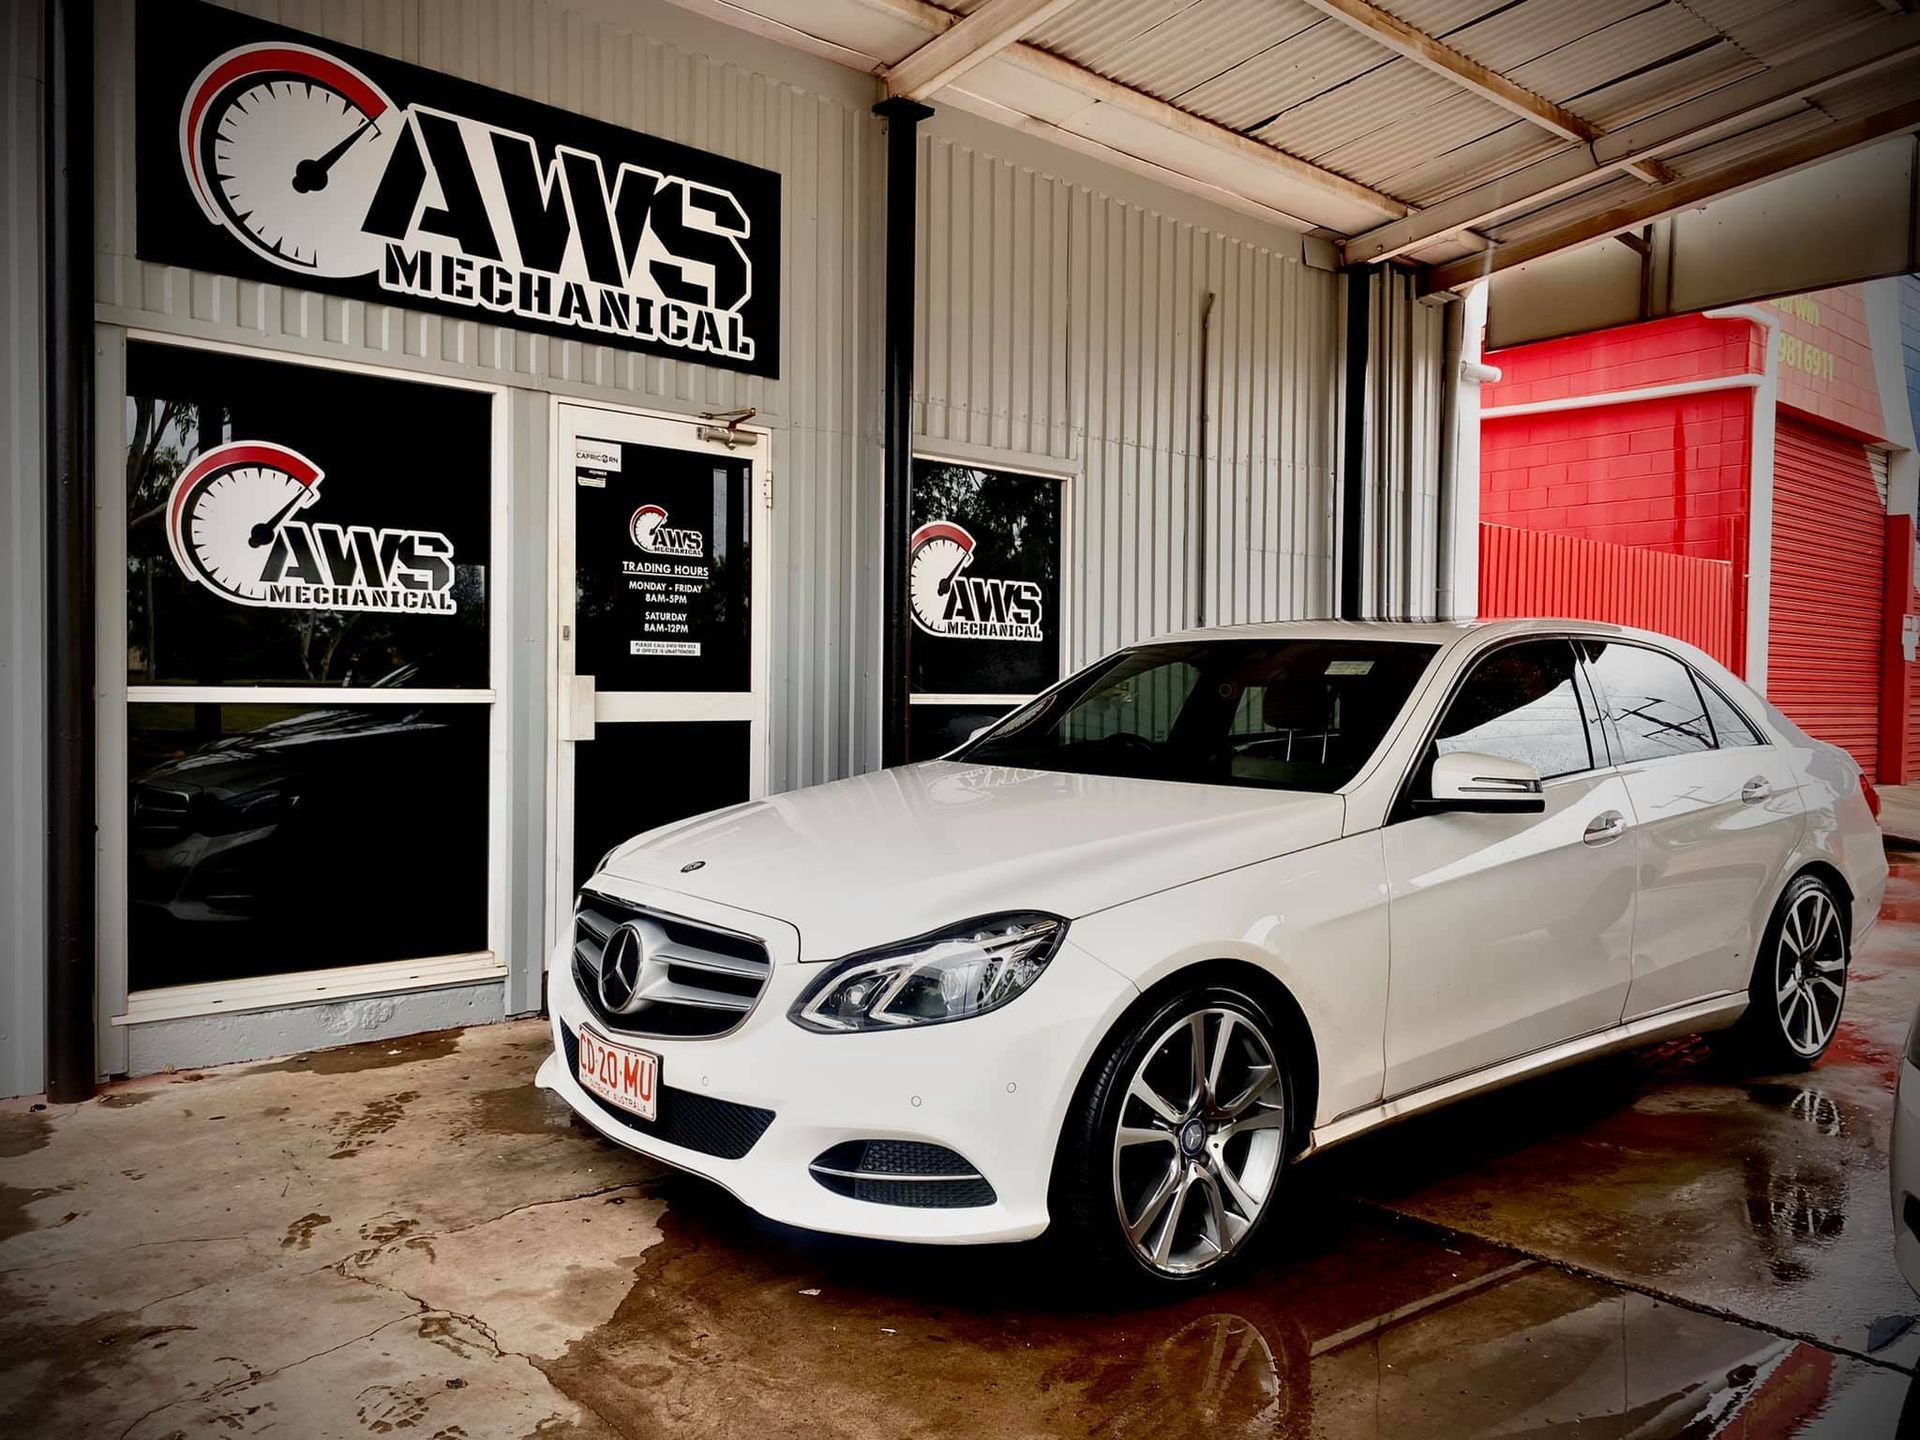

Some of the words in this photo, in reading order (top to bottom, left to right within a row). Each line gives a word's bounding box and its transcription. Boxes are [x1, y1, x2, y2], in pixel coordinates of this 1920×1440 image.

[359, 104, 750, 308] AWS
[383, 241, 753, 357] MECHANICAL
[651, 528, 702, 550] AWS
[259, 523, 454, 592] AWS
[653, 546, 703, 556] MECHANICAL
[622, 561, 671, 573] TRADING
[674, 564, 709, 576] HOURS
[628, 581, 667, 591] MONDAY
[674, 583, 703, 593] FRIDAY
[269, 583, 455, 612] MECHANICAL
[645, 593, 688, 604] 8AM-5PM
[942, 578, 1042, 625] AWS
[645, 611, 688, 621] SATURDAY
[644, 623, 689, 633] 8AM-12PM
[946, 621, 1042, 639] MECHANICAL
